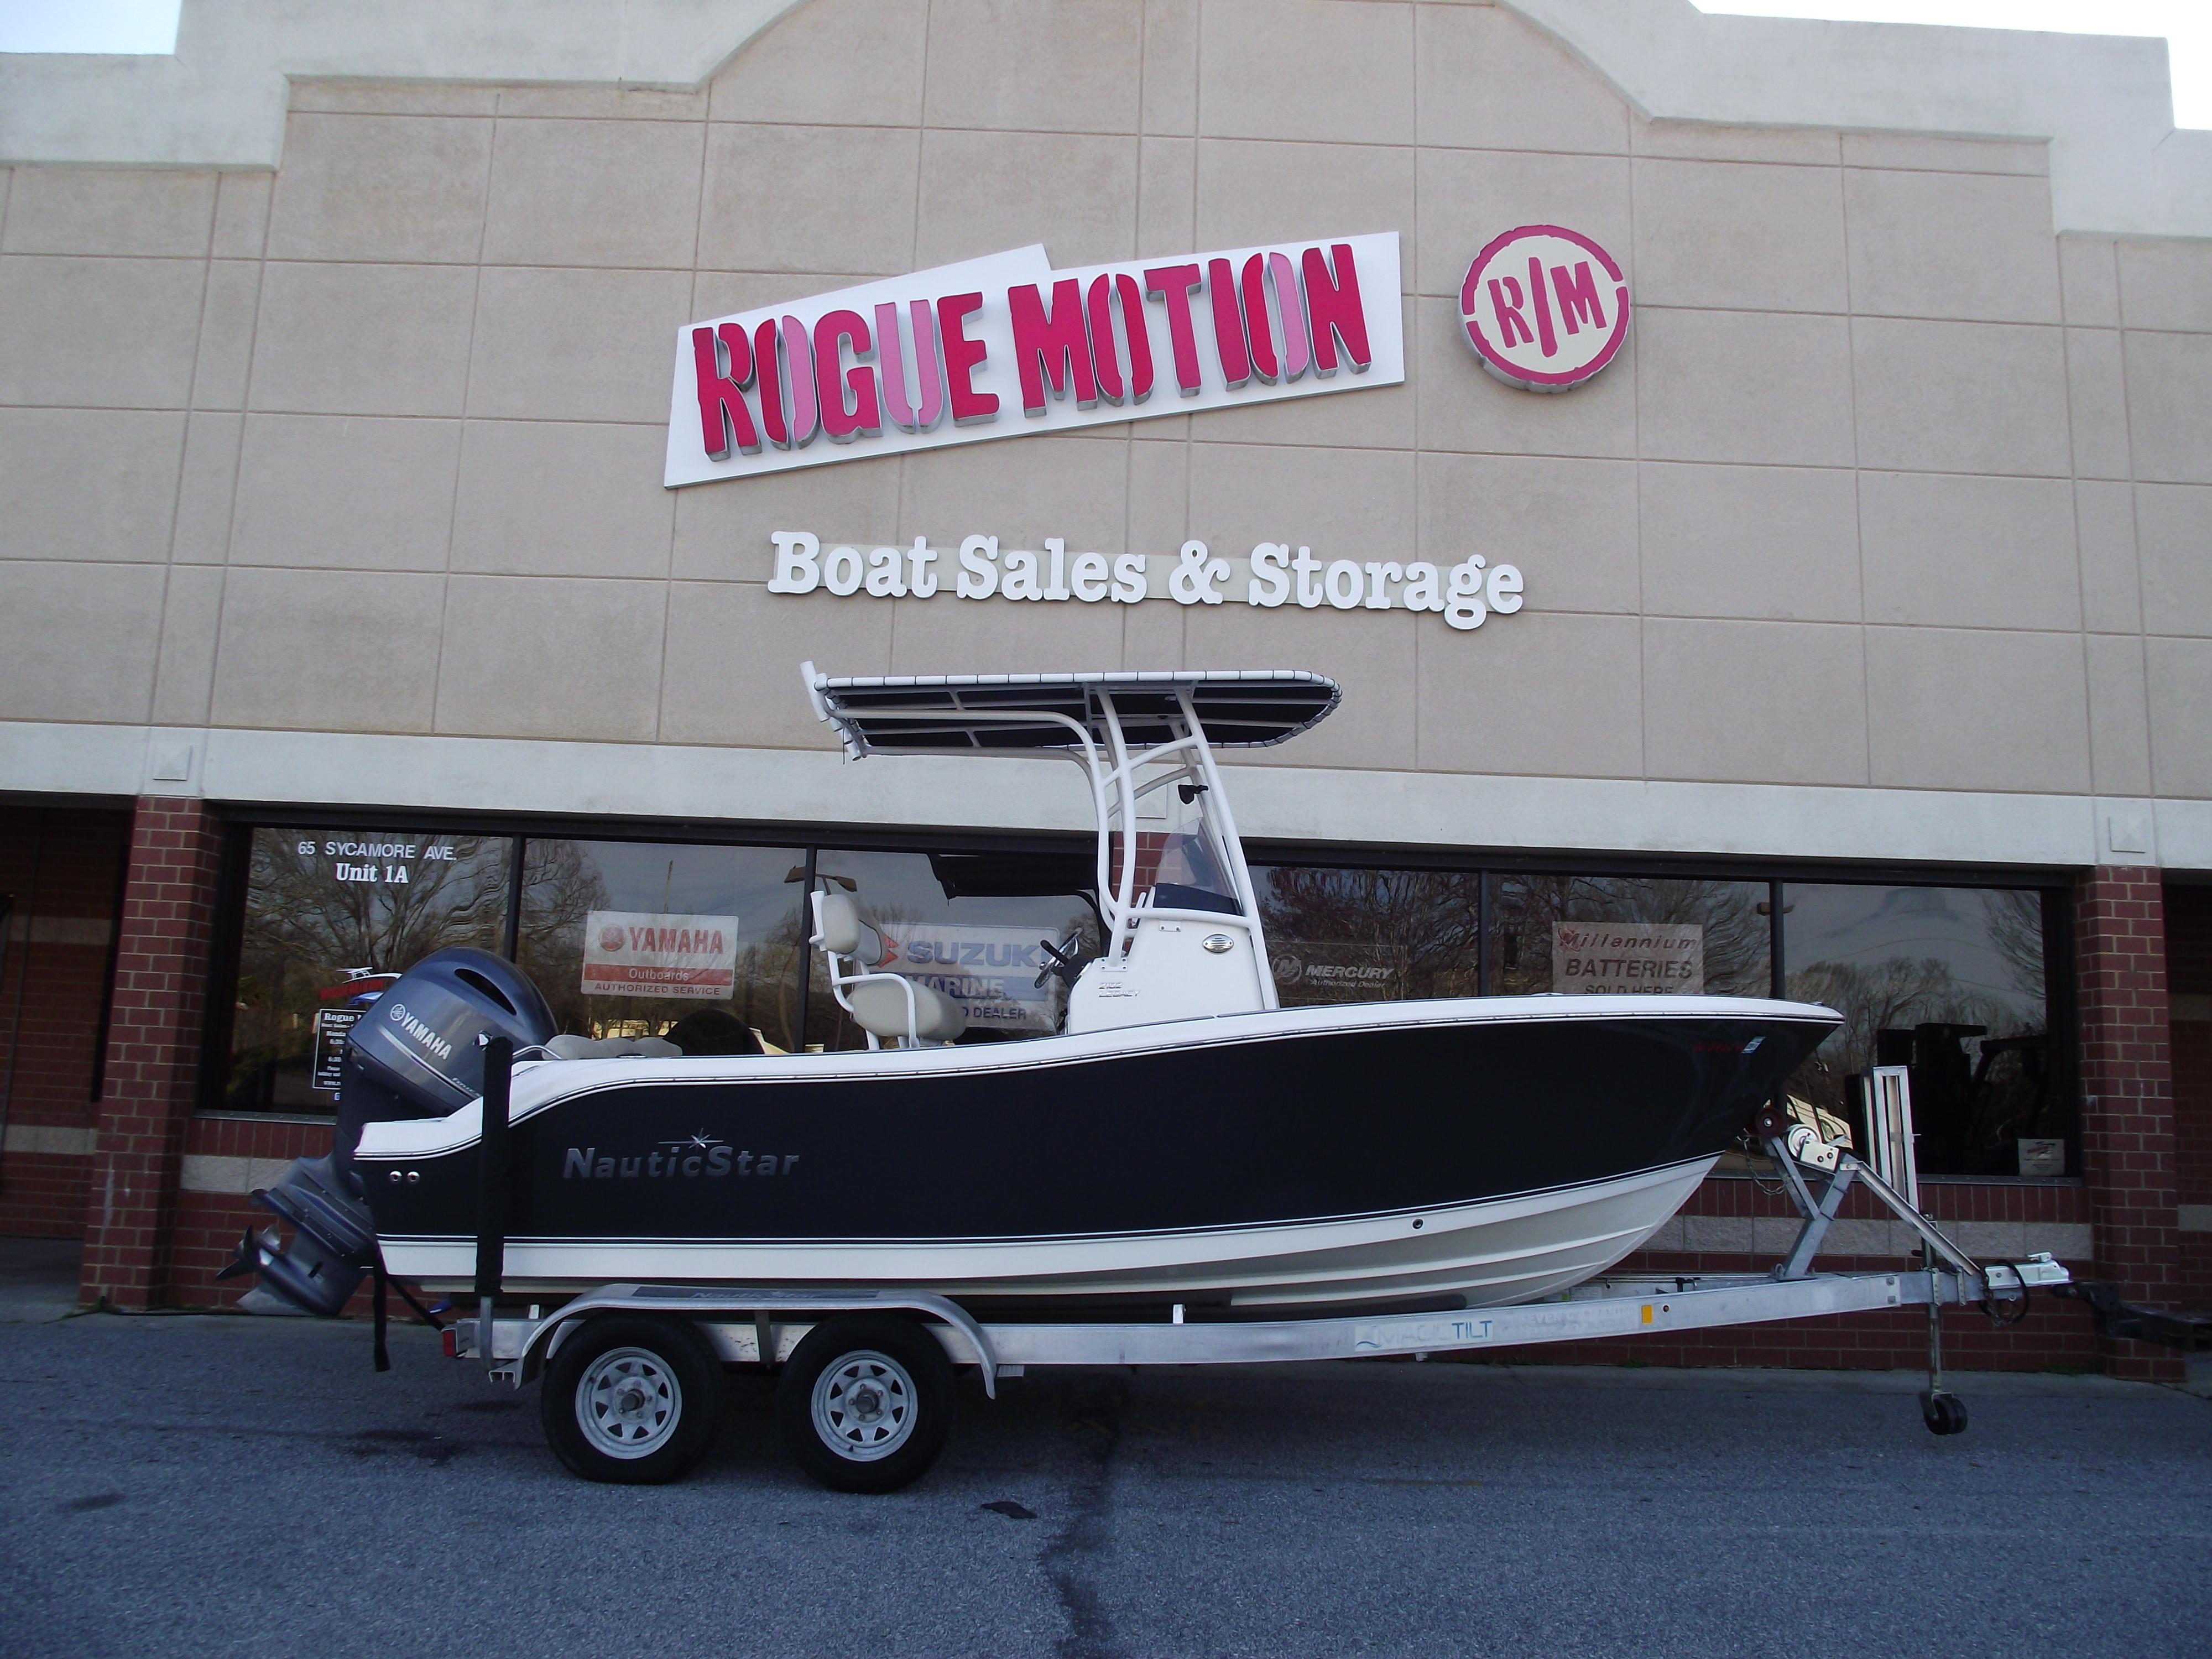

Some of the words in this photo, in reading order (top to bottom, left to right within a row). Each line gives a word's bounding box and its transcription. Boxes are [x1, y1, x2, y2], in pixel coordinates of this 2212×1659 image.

[692, 291, 1000, 461] ROGUE
[1007, 243, 1372, 418] MOTION
[767, 531, 938, 599] Boat
[956, 534, 1148, 604] Sales
[1168, 540, 1231, 606] &
[1248, 542, 1524, 630] Storage
[298, 841, 316, 855] 65
[325, 842, 416, 859] SYCAMORE
[423, 846, 457, 861] AVE.
[336, 863, 378, 883] Unit
[384, 865, 409, 884] 1A
[629, 927, 724, 954] YAMAHA
[1559, 932, 1697, 950] Millennium
[629, 968, 691, 982] Outboards
[1305, 964, 1395, 979] MERCURY
[1565, 958, 1693, 979] BATTERIES
[594, 983, 669, 994] AUTHORIZED
[672, 986, 721, 996] SERVICE
[1311, 978, 1355, 988] Authorized
[1358, 980, 1385, 989] Dealer
[324, 1013, 355, 1022] Rogue
[974, 1006, 1027, 1020] DEALER
[400, 1011, 452, 1060] YAMAHA
[562, 1145, 800, 1179] NauticStar
[1452, 1320, 1493, 1339] TILT
